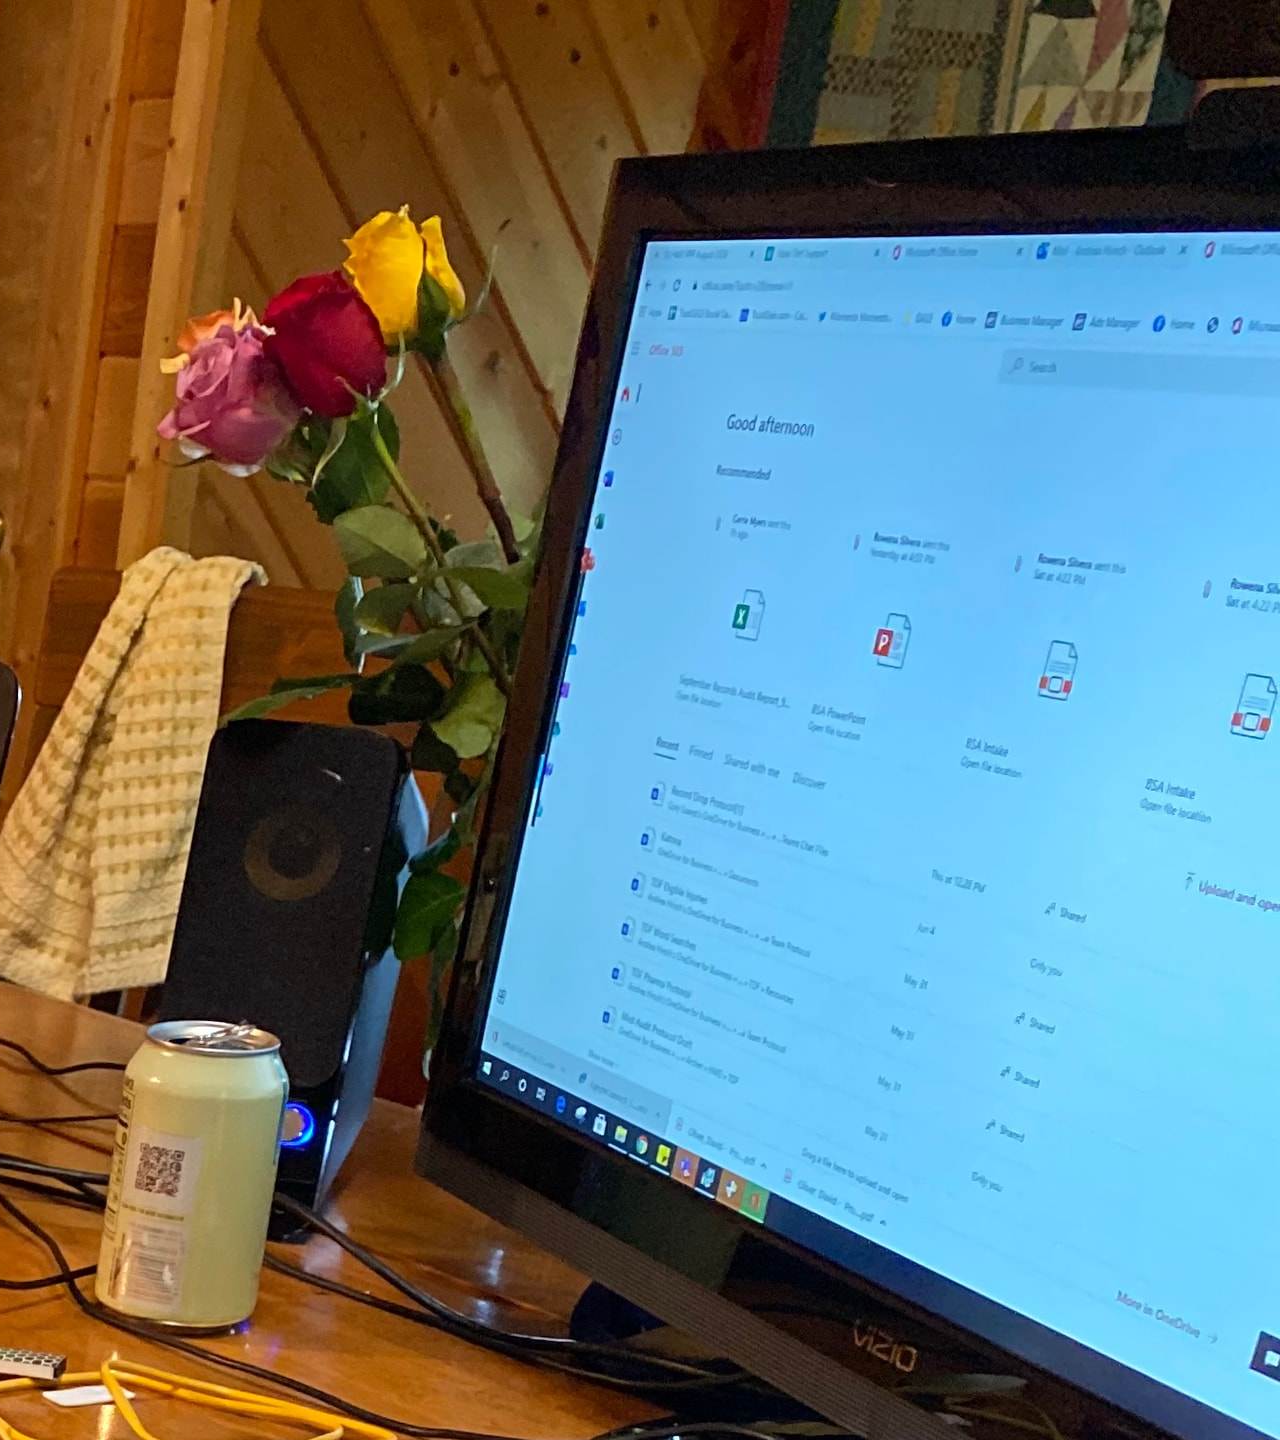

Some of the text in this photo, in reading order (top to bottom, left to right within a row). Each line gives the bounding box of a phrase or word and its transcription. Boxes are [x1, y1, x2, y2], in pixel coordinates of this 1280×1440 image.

[1031, 315, 1064, 330] Manager
[1089, 316, 1142, 332] Ads Manager
[1029, 361, 1057, 374] Search
[727, 413, 815, 437] Good afternoon
[716, 464, 772, 481] Recommended
[870, 548, 899, 563] Yesterday
[1033, 568, 1046, 580] Sat
[1073, 574, 1086, 586] PM
[1225, 595, 1240, 608] Sat
[827, 706, 867, 726] PowerPoint
[807, 720, 824, 735] Open
[837, 727, 861, 742] location
[983, 741, 1009, 758] Intake
[655, 736, 680, 752] Recent
[723, 753, 749, 770] Shared
[792, 771, 827, 790] Discover
[960, 755, 980, 770] Open
[992, 764, 1022, 780] location
[1144, 777, 1196, 800] BSA Intake
[1139, 797, 1212, 825] Open file location
[1197, 880, 1235, 901] Upload
[1236, 889, 1256, 907] and
[1060, 907, 1088, 924] Shared
[1030, 958, 1063, 978] Only you
[904, 973, 919, 989] May
[891, 1025, 905, 1041] May
[1030, 1017, 1056, 1035] Shared
[877, 1075, 892, 1092] May
[1014, 1070, 1040, 1089] Shared
[865, 1126, 879, 1141] May
[1000, 1123, 1025, 1143] Shared
[802, 1147, 816, 1164] Drag
[856, 1172, 877, 1190] upload
[878, 1182, 892, 1195] and
[892, 1189, 909, 1203] open
[972, 1170, 1003, 1194] Only you
[1115, 1290, 1142, 1312] More
[1155, 1308, 1202, 1340] OneDrive
[852, 1319, 919, 1374] VIZIO
